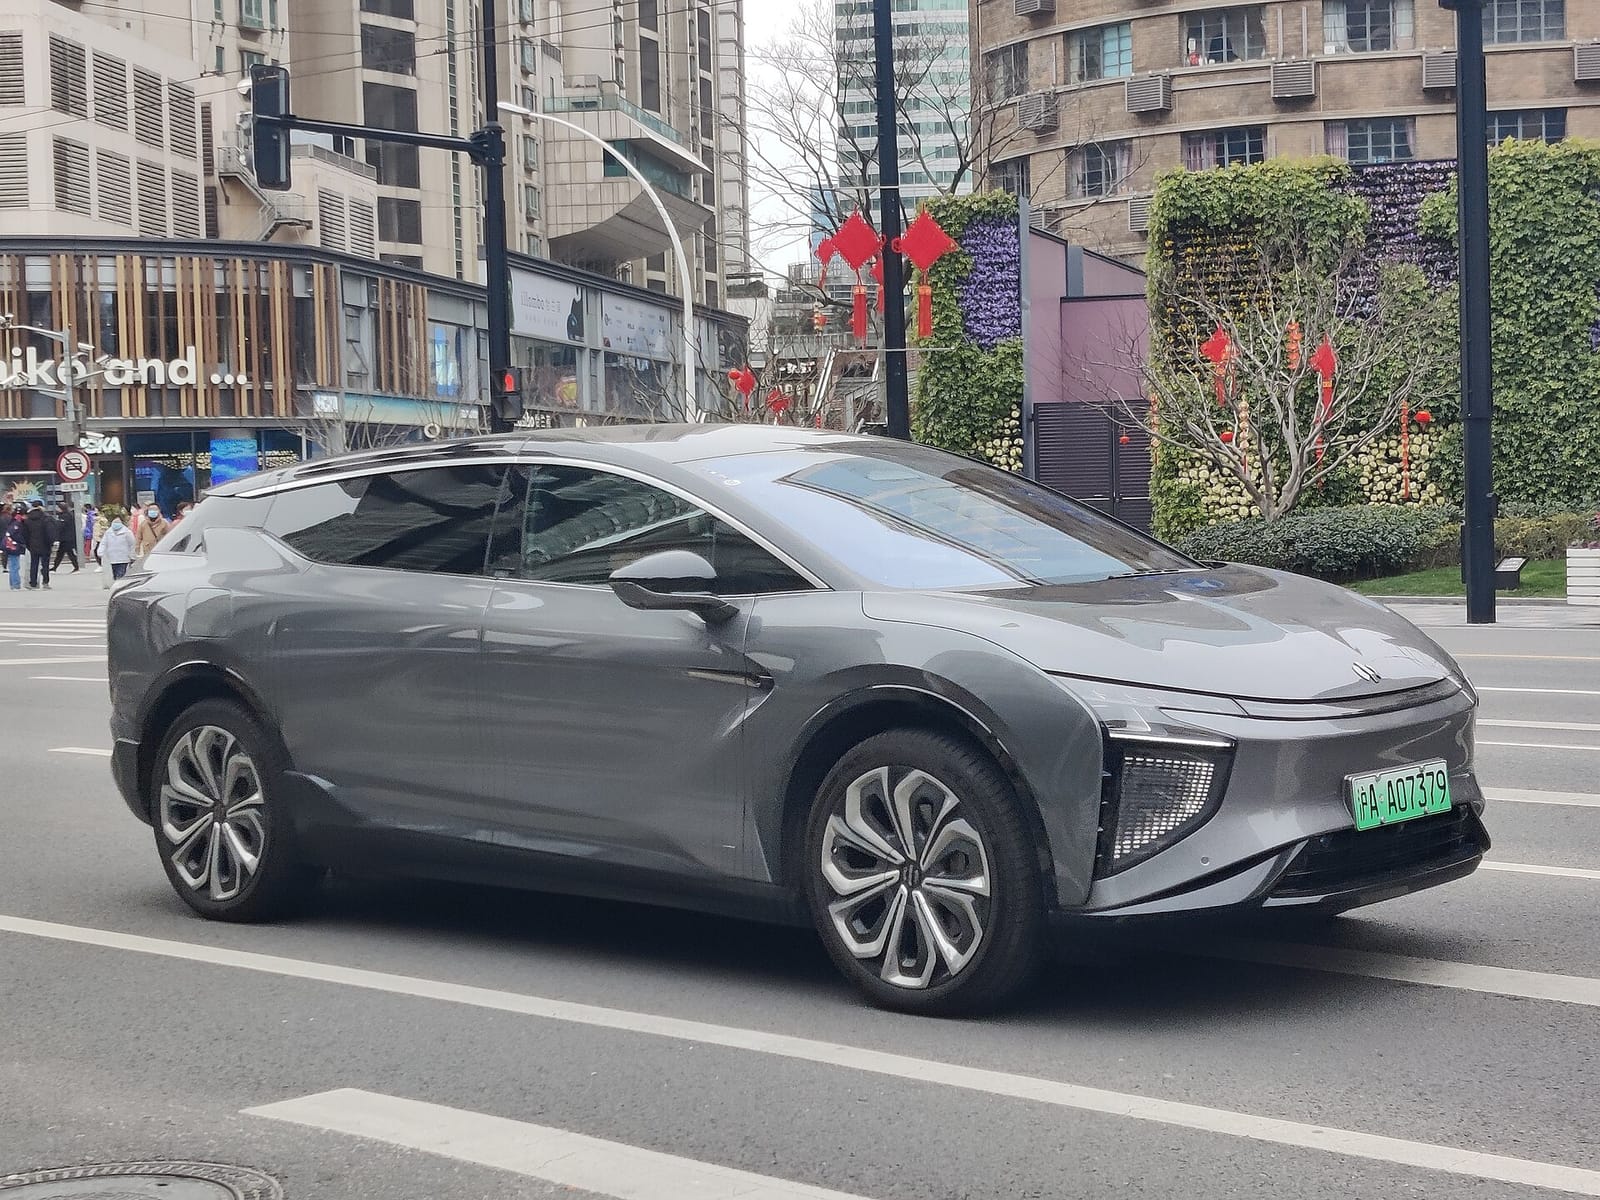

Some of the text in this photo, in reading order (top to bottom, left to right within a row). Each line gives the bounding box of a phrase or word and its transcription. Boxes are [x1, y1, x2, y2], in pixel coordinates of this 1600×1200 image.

[104, 346, 197, 386] and
[1357, 769, 1447, 822] 沪A A07379
